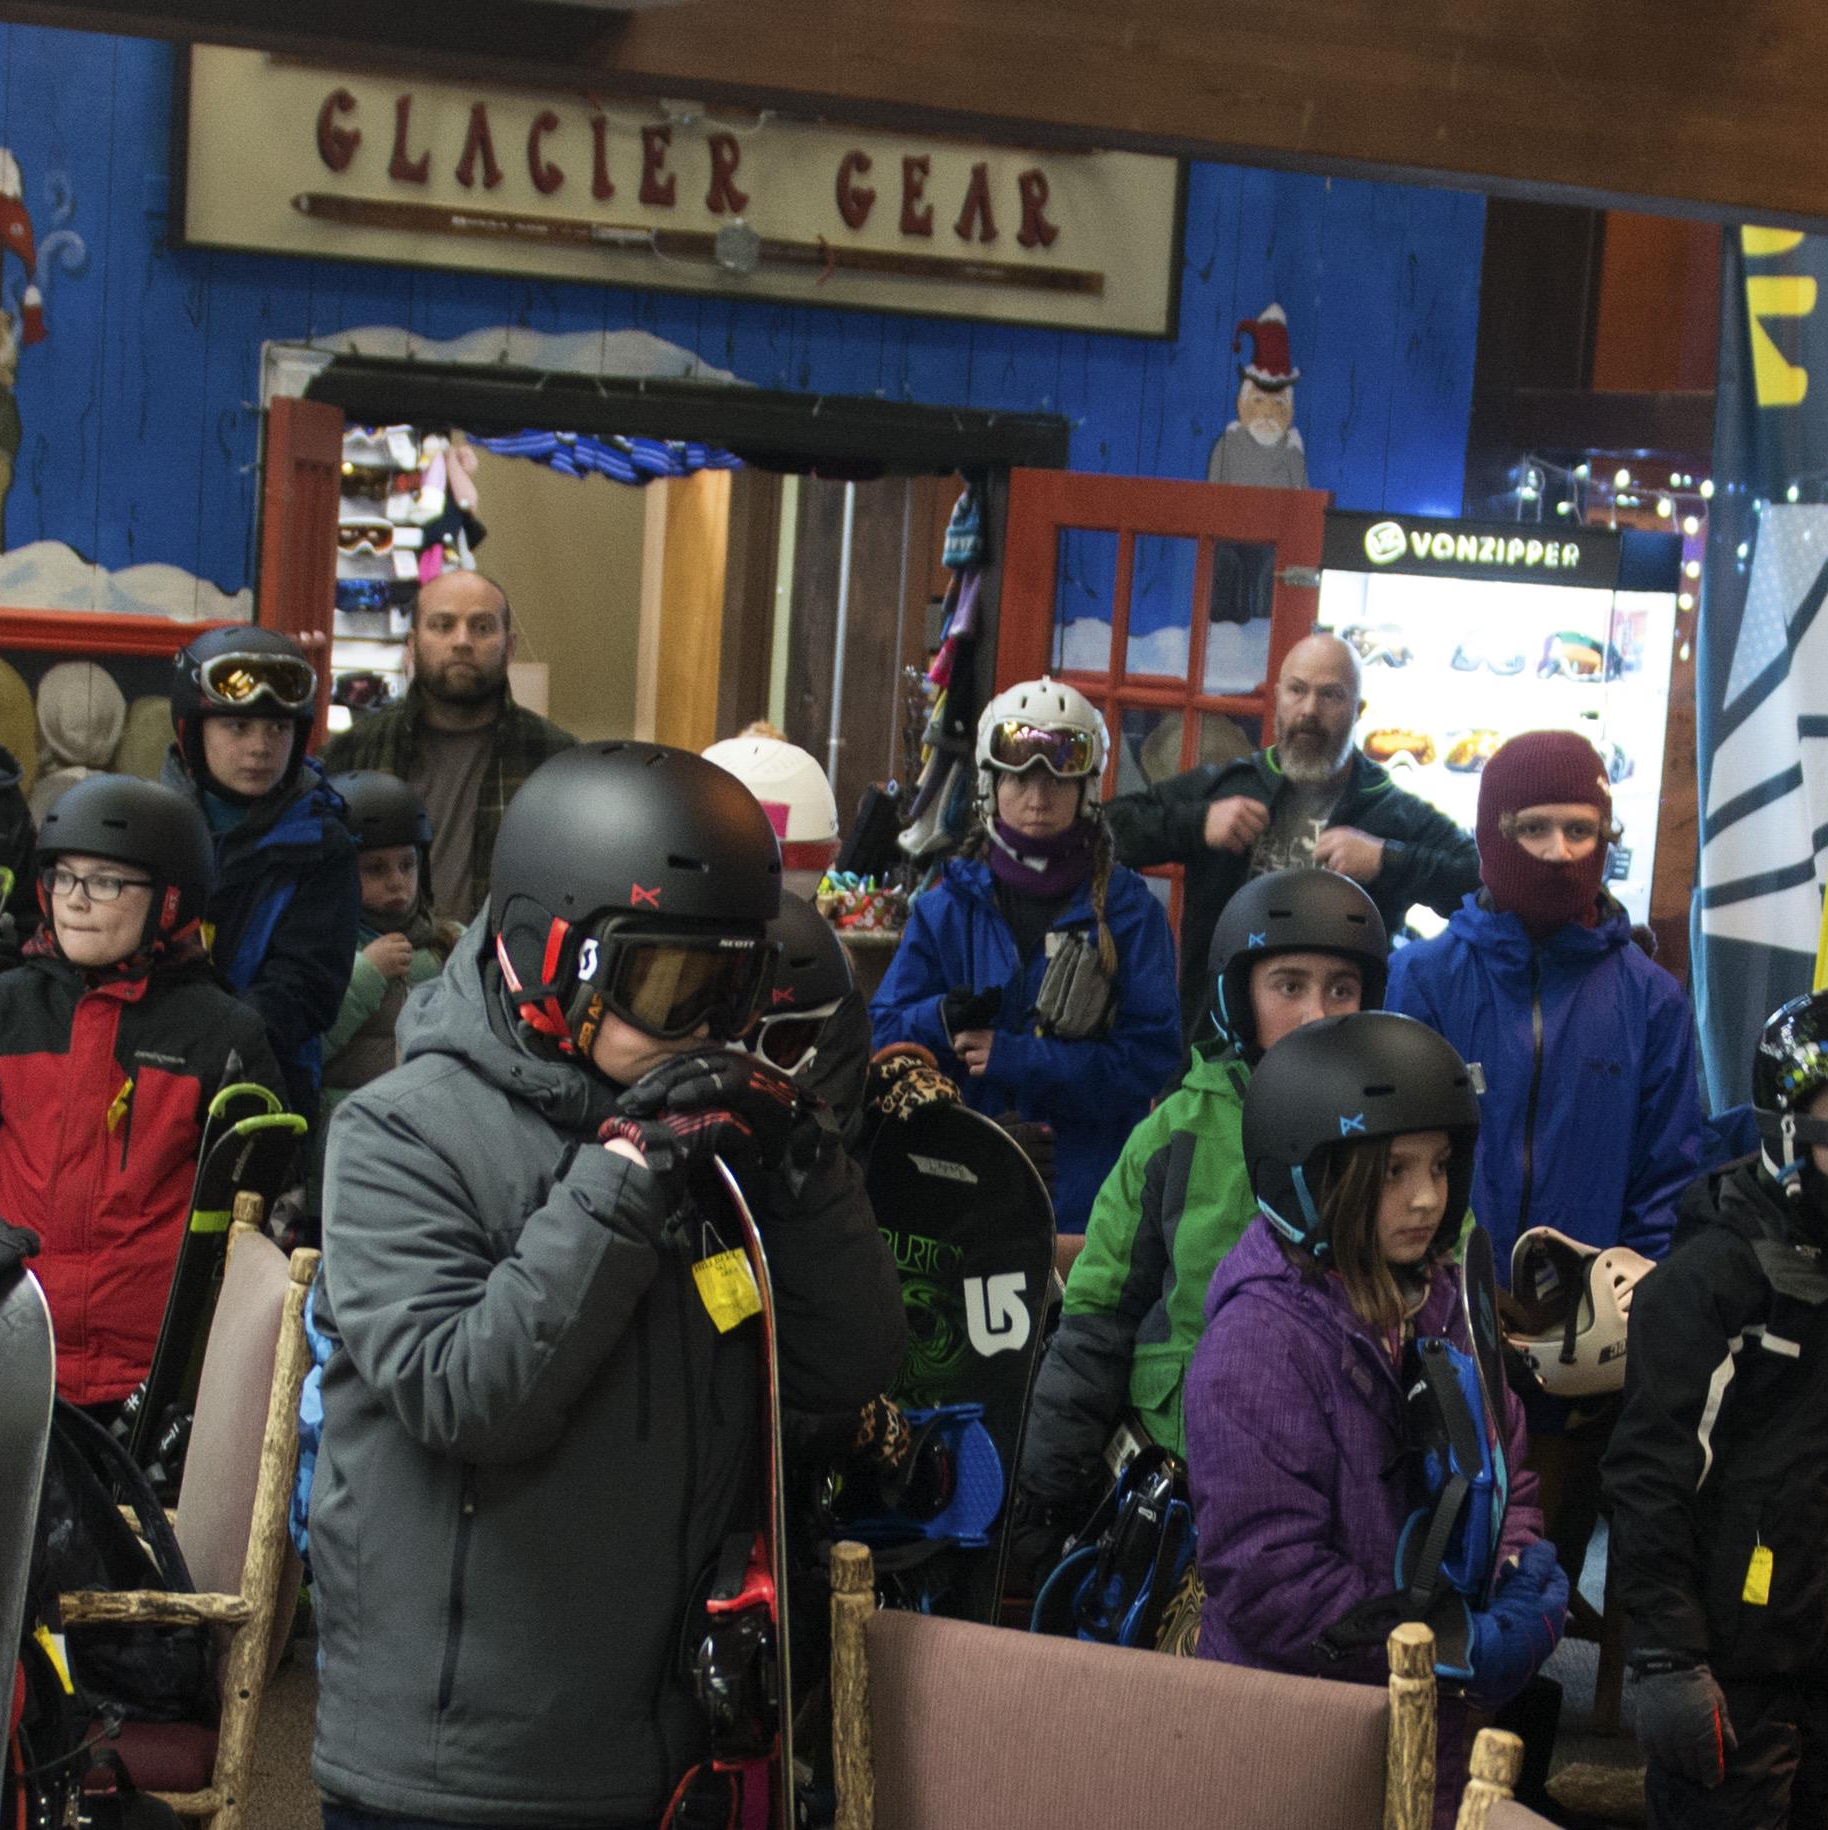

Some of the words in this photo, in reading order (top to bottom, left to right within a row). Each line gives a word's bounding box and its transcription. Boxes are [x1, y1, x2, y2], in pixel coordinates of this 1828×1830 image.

[316, 87, 750, 215] GLACIER
[835, 149, 1060, 249] GEAR
[1410, 530, 1580, 569] VONZIPPER
